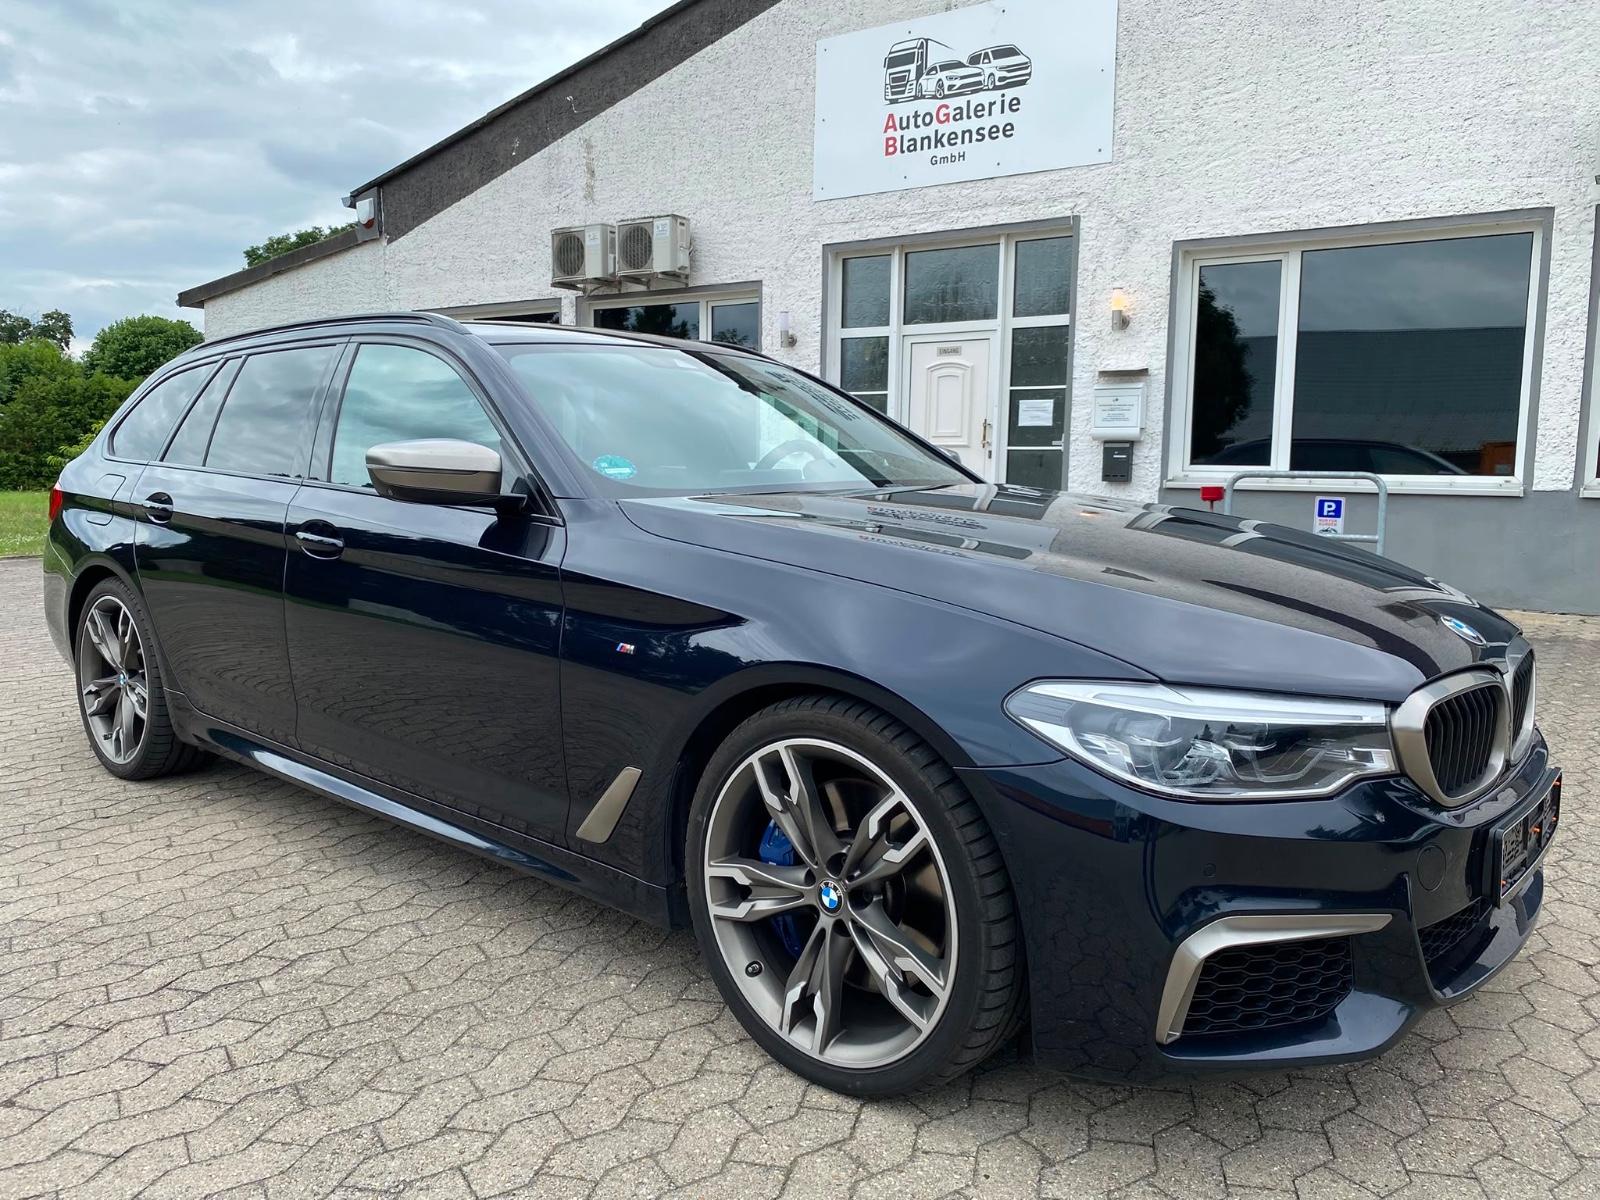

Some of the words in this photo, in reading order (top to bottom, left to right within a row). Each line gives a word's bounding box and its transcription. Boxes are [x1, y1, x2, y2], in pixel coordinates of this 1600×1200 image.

[883, 93, 1021, 133] AutoGalerie
[884, 122, 1015, 156] Blankensee
[930, 151, 966, 166] GmbH
[1323, 501, 1336, 516] P
[820, 882, 842, 896] BMW
